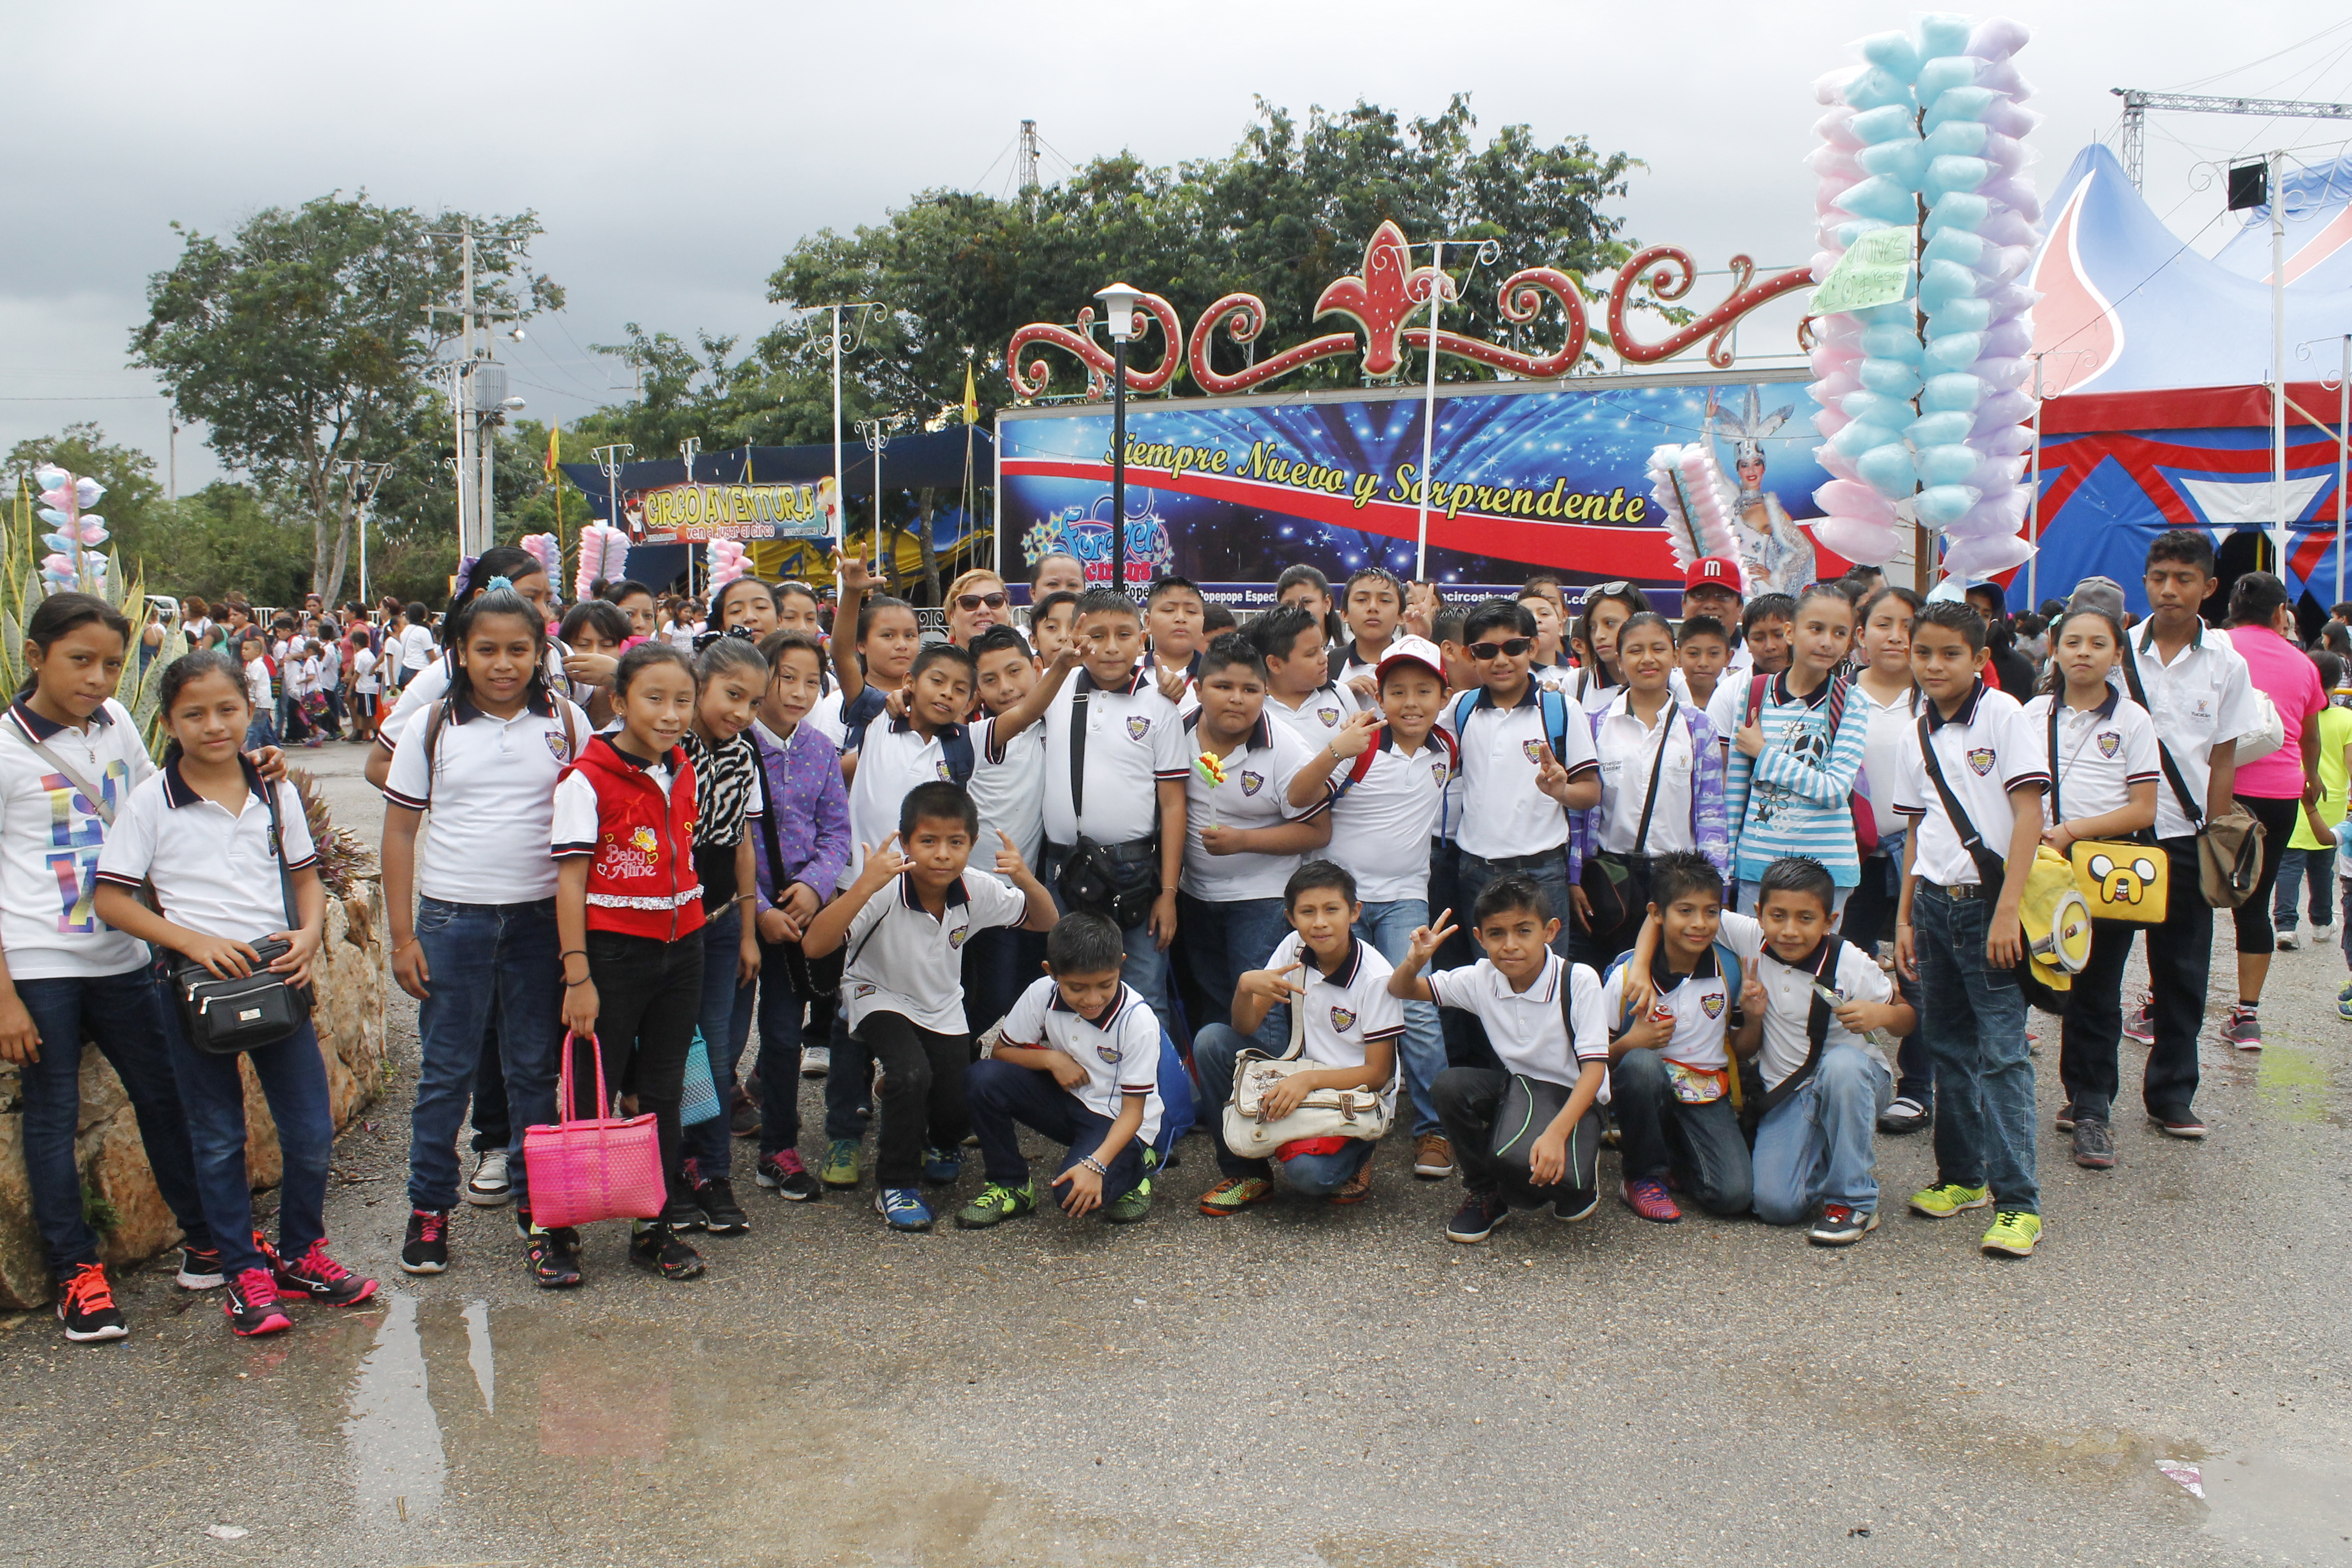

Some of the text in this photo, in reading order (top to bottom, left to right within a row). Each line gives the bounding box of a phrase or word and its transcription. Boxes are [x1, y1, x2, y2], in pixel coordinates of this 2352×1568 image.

[1104, 430, 1645, 524] Siempre Nuevo y Sorprendente
[646, 484, 815, 527] CIRCO AVENTURA
[687, 527, 706, 539] ven
[707, 527, 714, 538] a
[716, 525, 739, 540] jugar
[752, 524, 775, 537] circo
[1085, 561, 1151, 582] cirus
[606, 844, 646, 865] Baby
[607, 862, 657, 879] Aline
